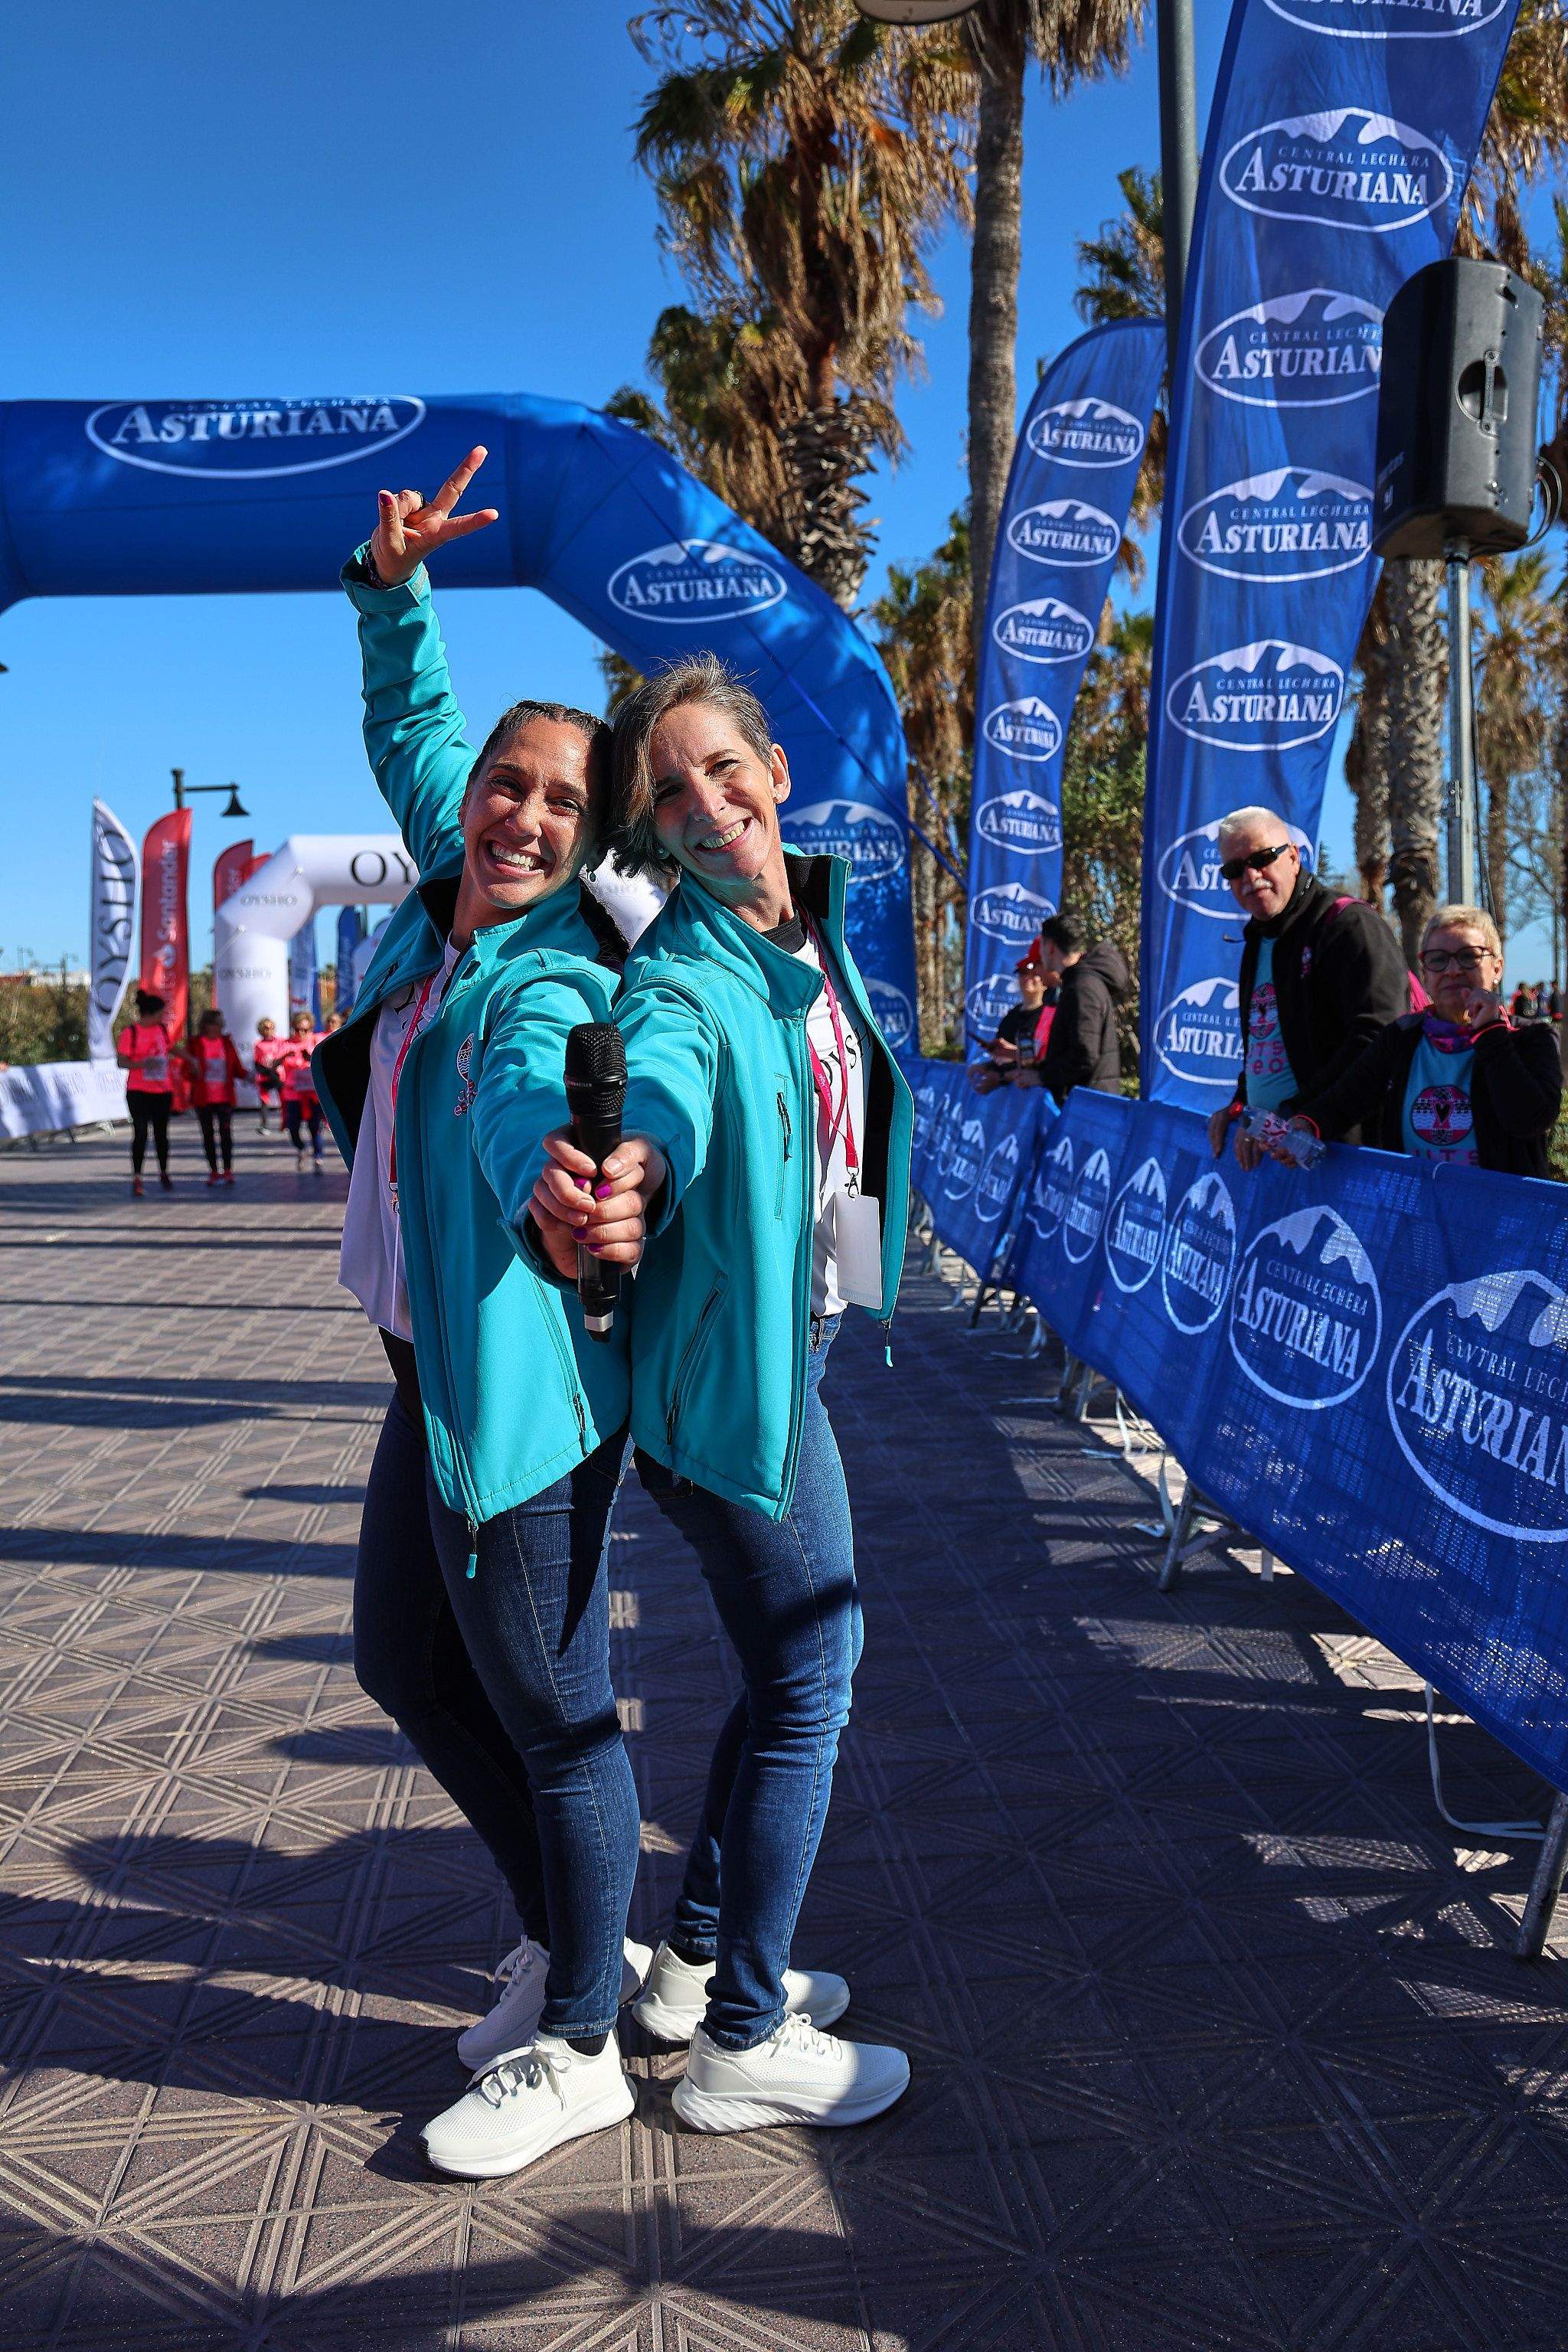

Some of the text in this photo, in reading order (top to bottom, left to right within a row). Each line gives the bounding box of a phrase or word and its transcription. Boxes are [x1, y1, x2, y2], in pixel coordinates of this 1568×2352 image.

[1234, 146, 1429, 206] ASTURIANA
[1278, 145, 1430, 168] CENTRAL LECHERA
[1212, 334, 1383, 379] ASTURIAN
[1250, 326, 1380, 345] CENTRAL LECHE
[109, 403, 401, 445] ASTURIANA
[1035, 421, 1137, 456] ASTURIANA
[1193, 510, 1370, 554] ASTURIANA
[1230, 503, 1370, 521] CENTRAL LECHERA
[1015, 518, 1112, 555] ASTURIANA
[623, 574, 776, 607] ASTURIANA
[1181, 681, 1334, 724] ASTURIANA
[157, 839, 178, 942] Santander
[96, 831, 135, 1014] OYSHO
[1239, 1256, 1361, 1380] ASTURIANA
